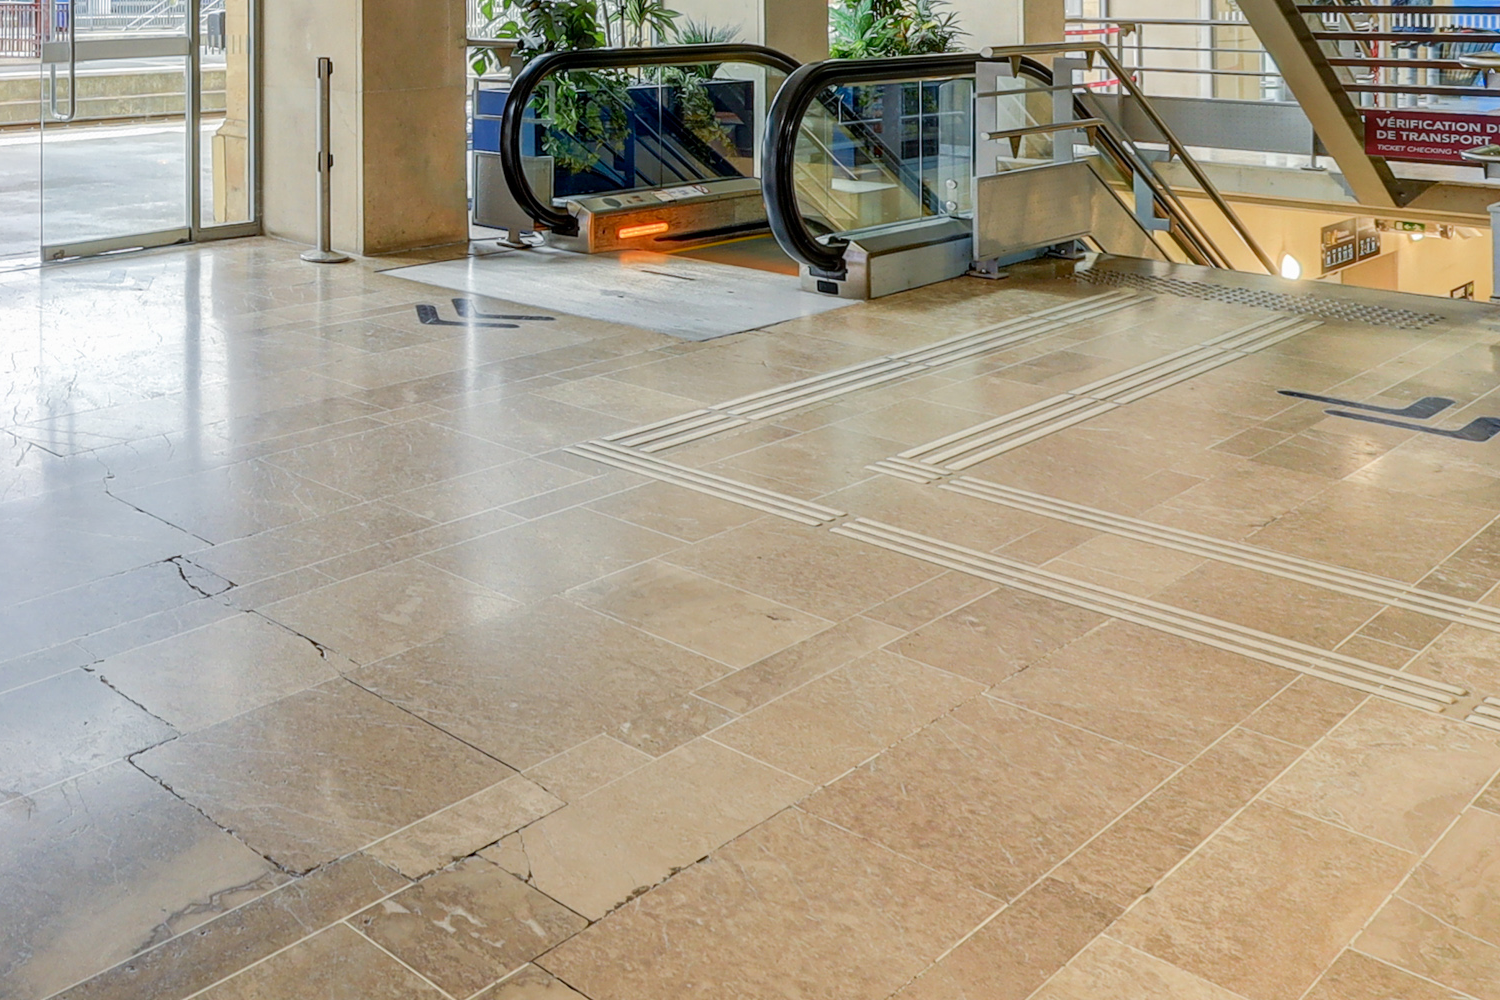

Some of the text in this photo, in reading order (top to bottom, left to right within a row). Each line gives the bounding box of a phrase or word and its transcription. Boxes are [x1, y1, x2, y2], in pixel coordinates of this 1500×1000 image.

[1376, 116, 1481, 133] VÉRIFICATION
[1376, 130, 1492, 146] DE TRANSPORT
[1377, 143, 1406, 152] TICKET
[1407, 145, 1452, 155] CHECKING
